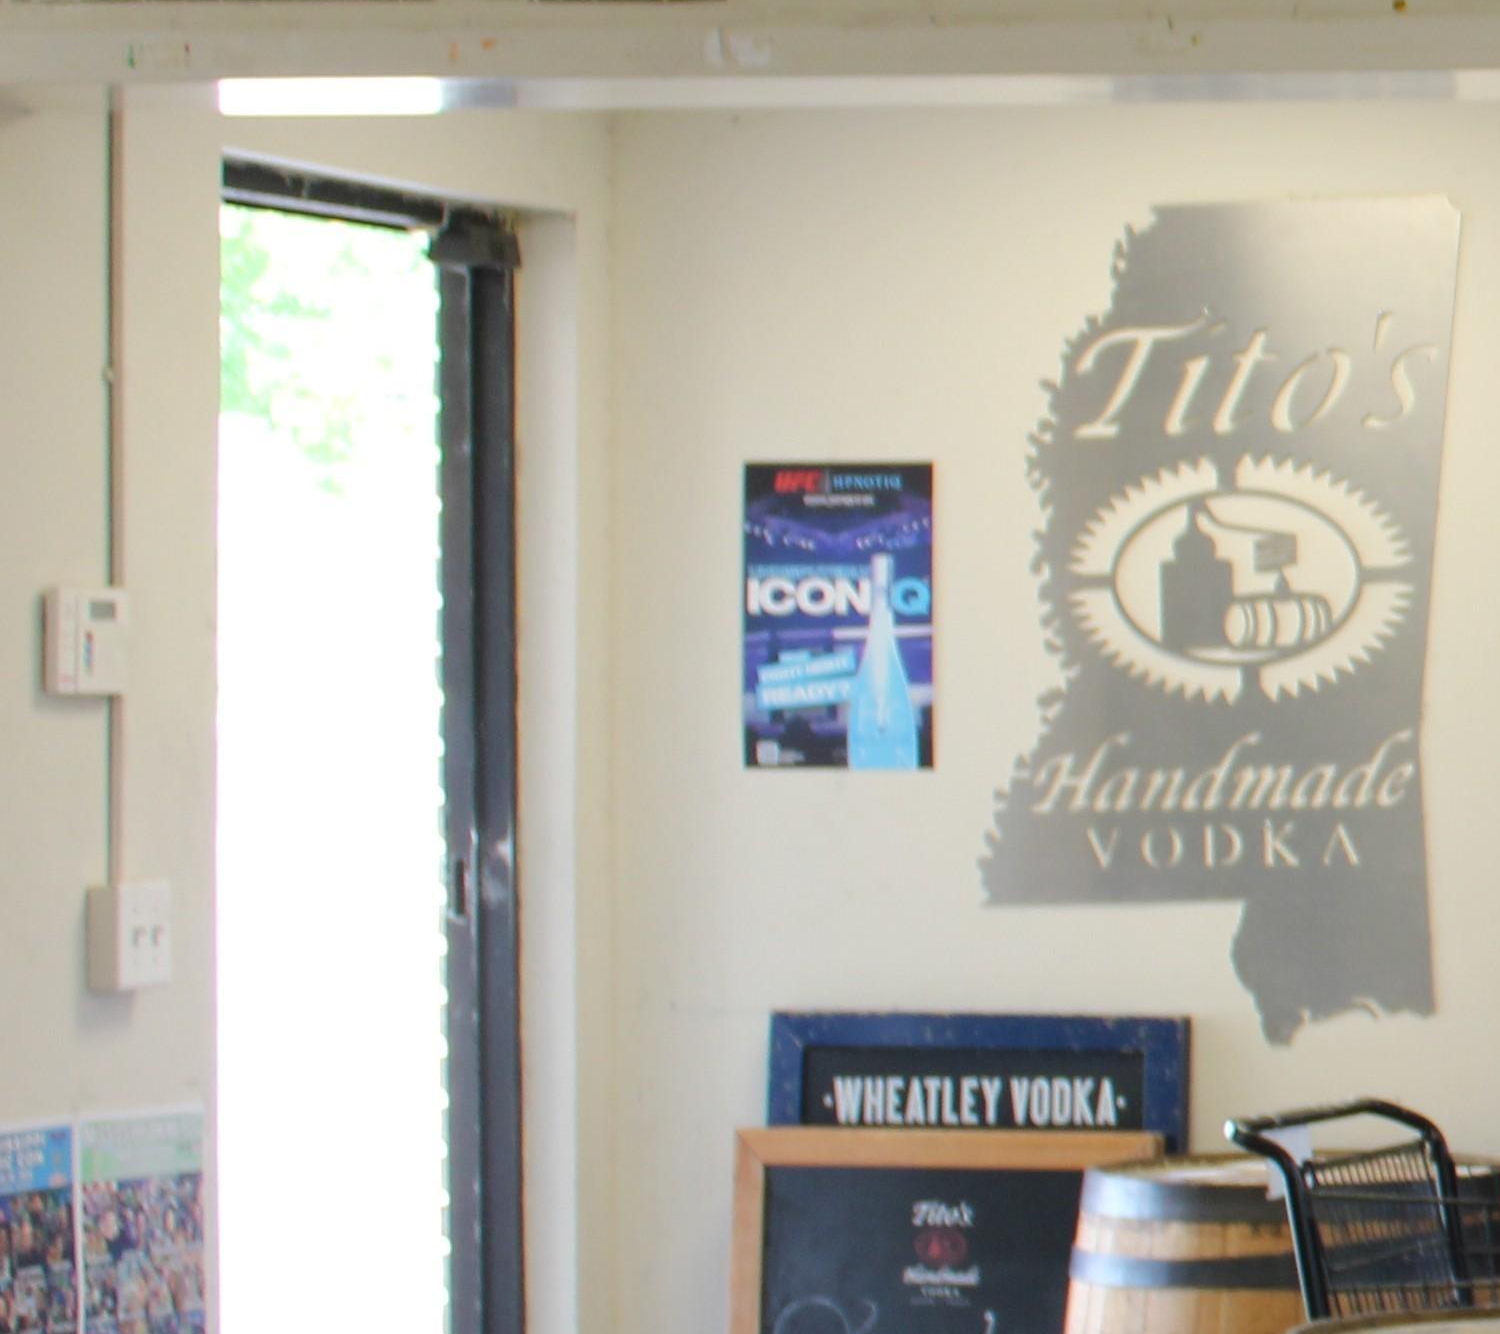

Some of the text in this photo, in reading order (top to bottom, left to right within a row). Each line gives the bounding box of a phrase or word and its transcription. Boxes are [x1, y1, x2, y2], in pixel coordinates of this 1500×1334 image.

[1073, 307, 1440, 440] Tito's
[1030, 727, 1414, 816] Handmade
[1085, 821, 1361, 869] VODKA
[832, 1074, 1118, 1126] WHEATLEY VODKA
